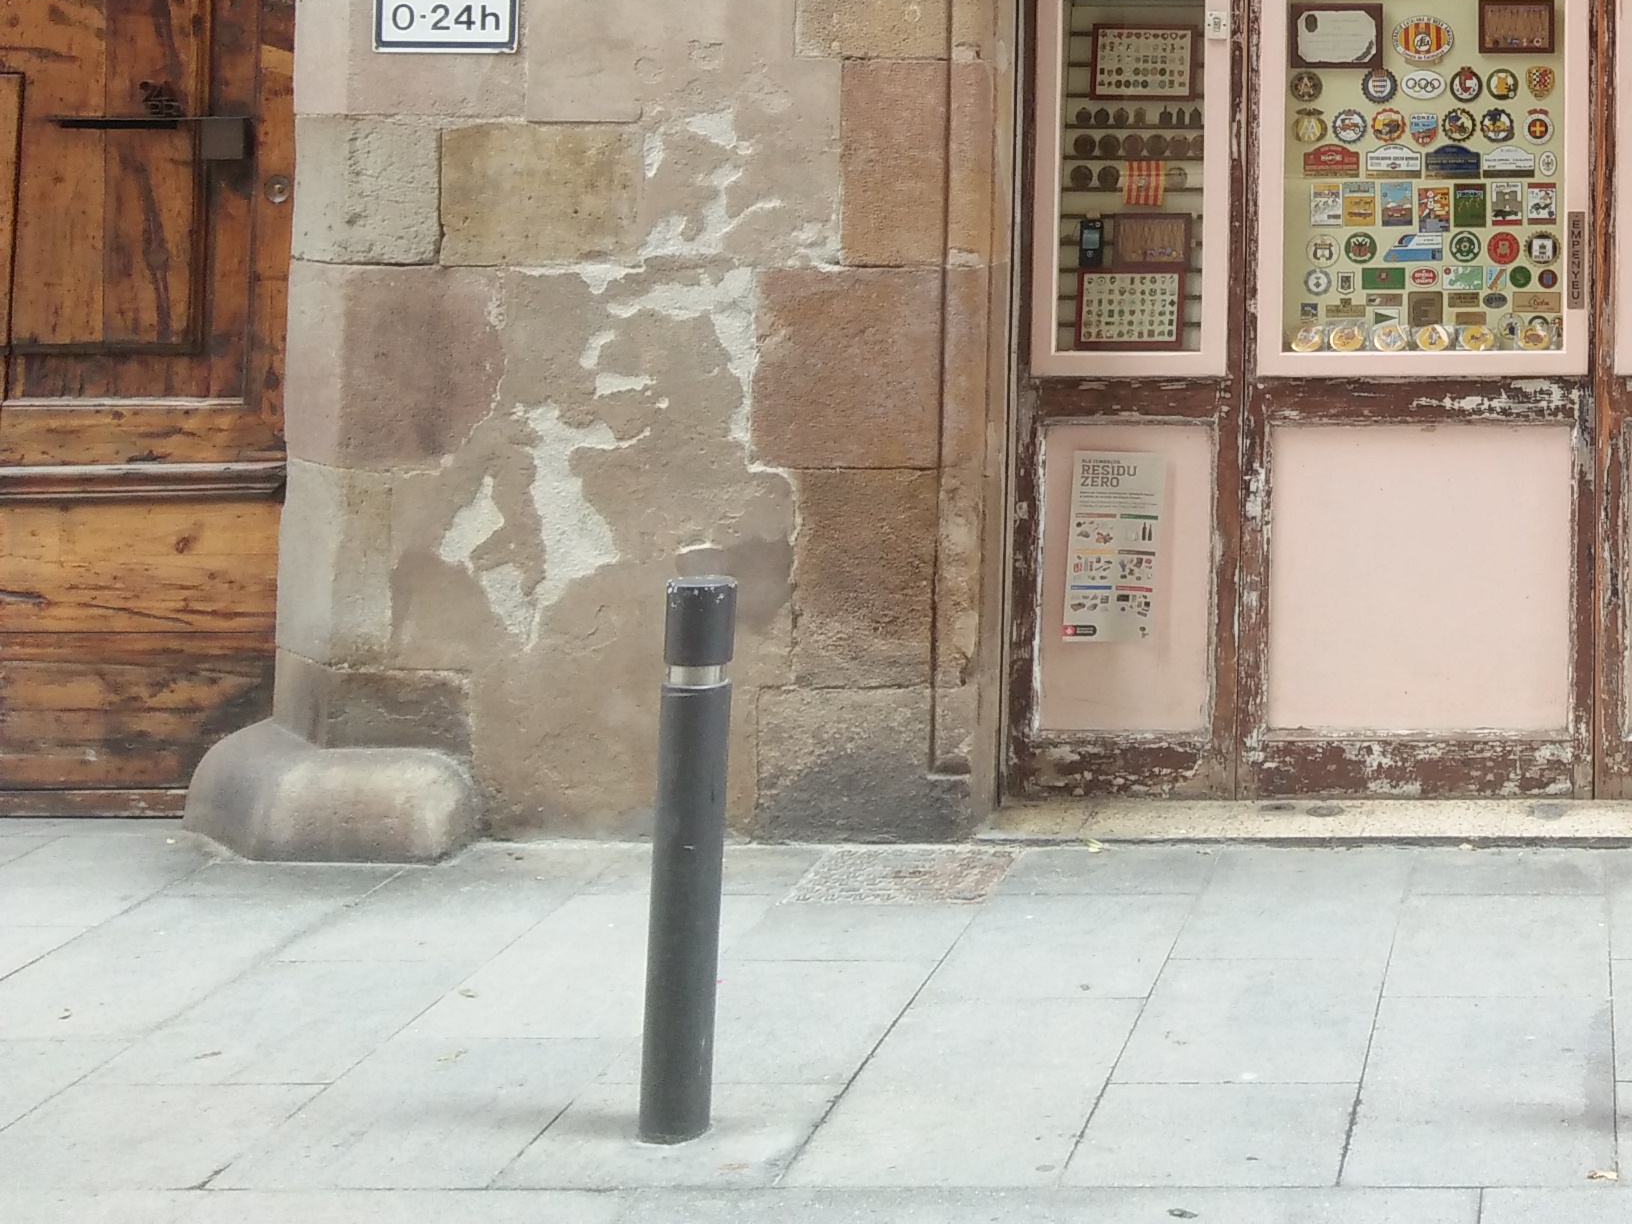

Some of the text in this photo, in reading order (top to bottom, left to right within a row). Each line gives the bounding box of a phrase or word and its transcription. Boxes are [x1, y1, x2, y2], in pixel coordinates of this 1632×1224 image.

[391, 3, 501, 32] 0-24h
[1570, 220, 1582, 300] EMPENYEU
[1081, 464, 1138, 477] RESIDU
[1080, 476, 1120, 488] ZERO
